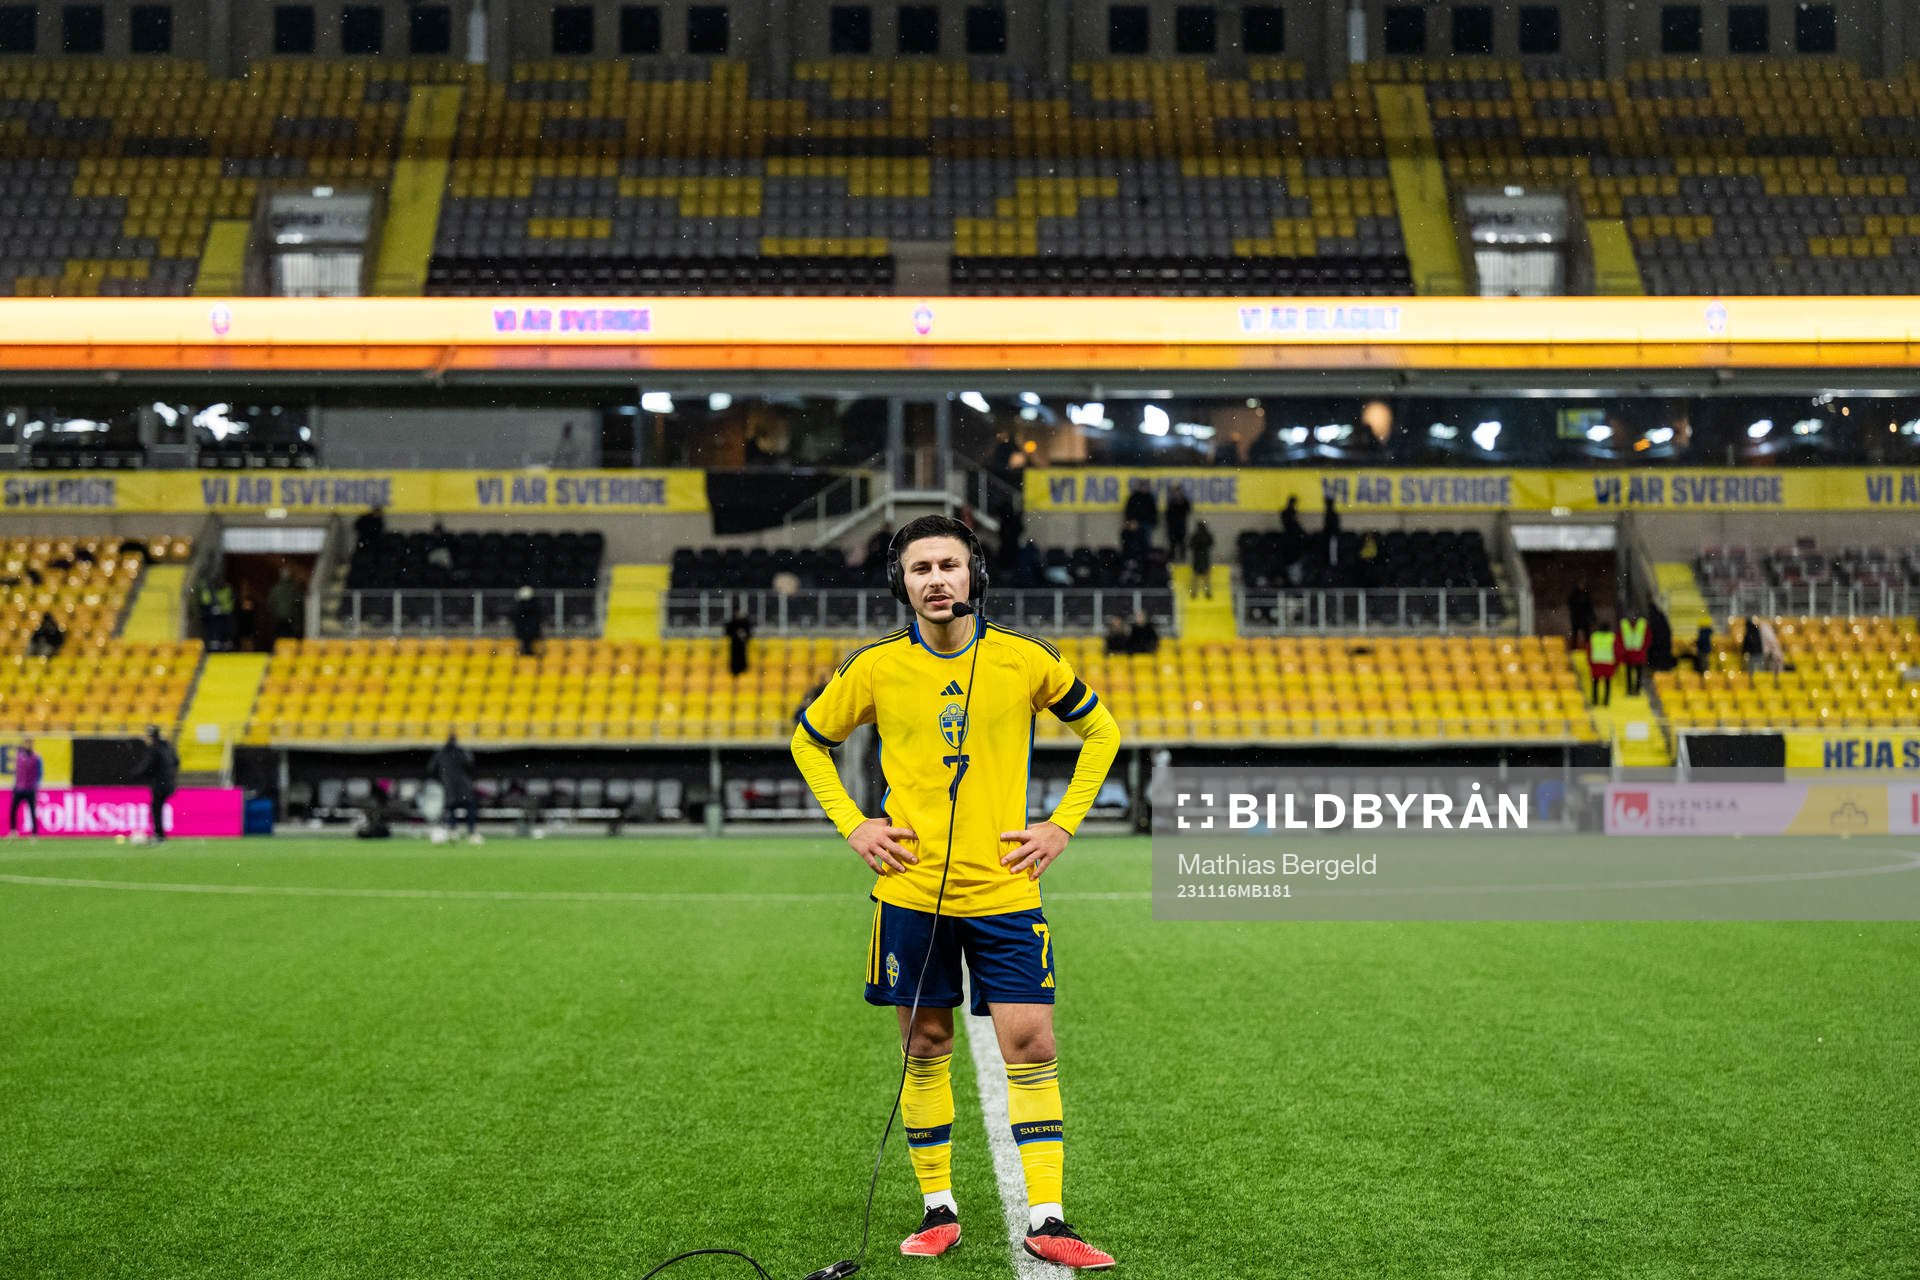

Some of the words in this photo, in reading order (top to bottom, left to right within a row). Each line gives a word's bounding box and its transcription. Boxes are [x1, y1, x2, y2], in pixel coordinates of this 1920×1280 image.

[201, 478, 228, 505] VI
[477, 477, 503, 505] VI
[556, 477, 667, 505] SVERIGE
[1049, 477, 1076, 504] VI
[1400, 476, 1511, 504] SVERIGE
[1594, 476, 1621, 504] VI
[1672, 476, 1783, 504] SVERIGE
[1866, 476, 1893, 504] VI
[1824, 741, 1894, 769] HEJA
[943, 755, 969, 801] 7
[1032, 924, 1050, 969] 7
